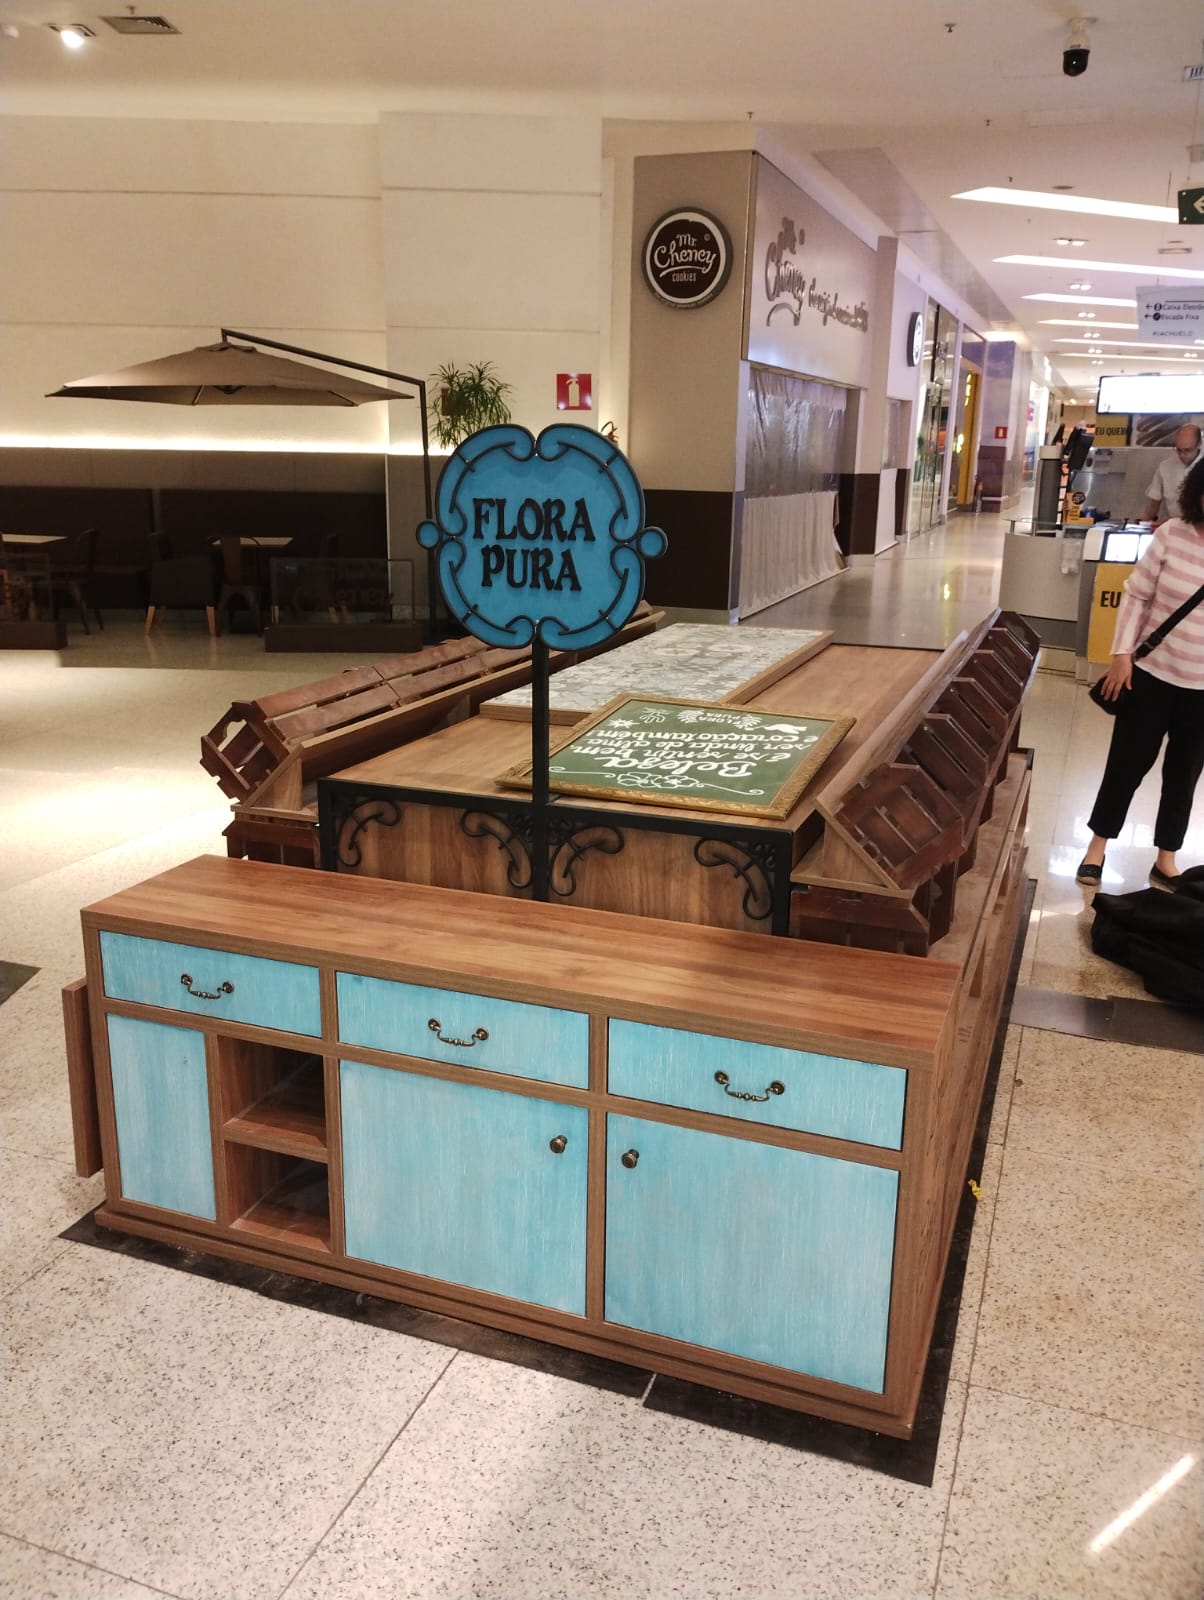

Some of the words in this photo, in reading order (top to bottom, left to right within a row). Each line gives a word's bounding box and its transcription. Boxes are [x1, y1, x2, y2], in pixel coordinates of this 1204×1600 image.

[676, 233, 697, 247] Mr.
[654, 240, 716, 274] Cheney
[472, 498, 596, 542] FLORA
[481, 545, 582, 592] PURA
[1100, 591, 1122, 608] EU
[587, 738, 651, 749] alma
[696, 733, 800, 742] coração
[655, 741, 684, 750] de
[687, 741, 757, 752] linda
[643, 749, 730, 759] sentir
[733, 752, 769, 760] se
[593, 756, 757, 778] Beleza
